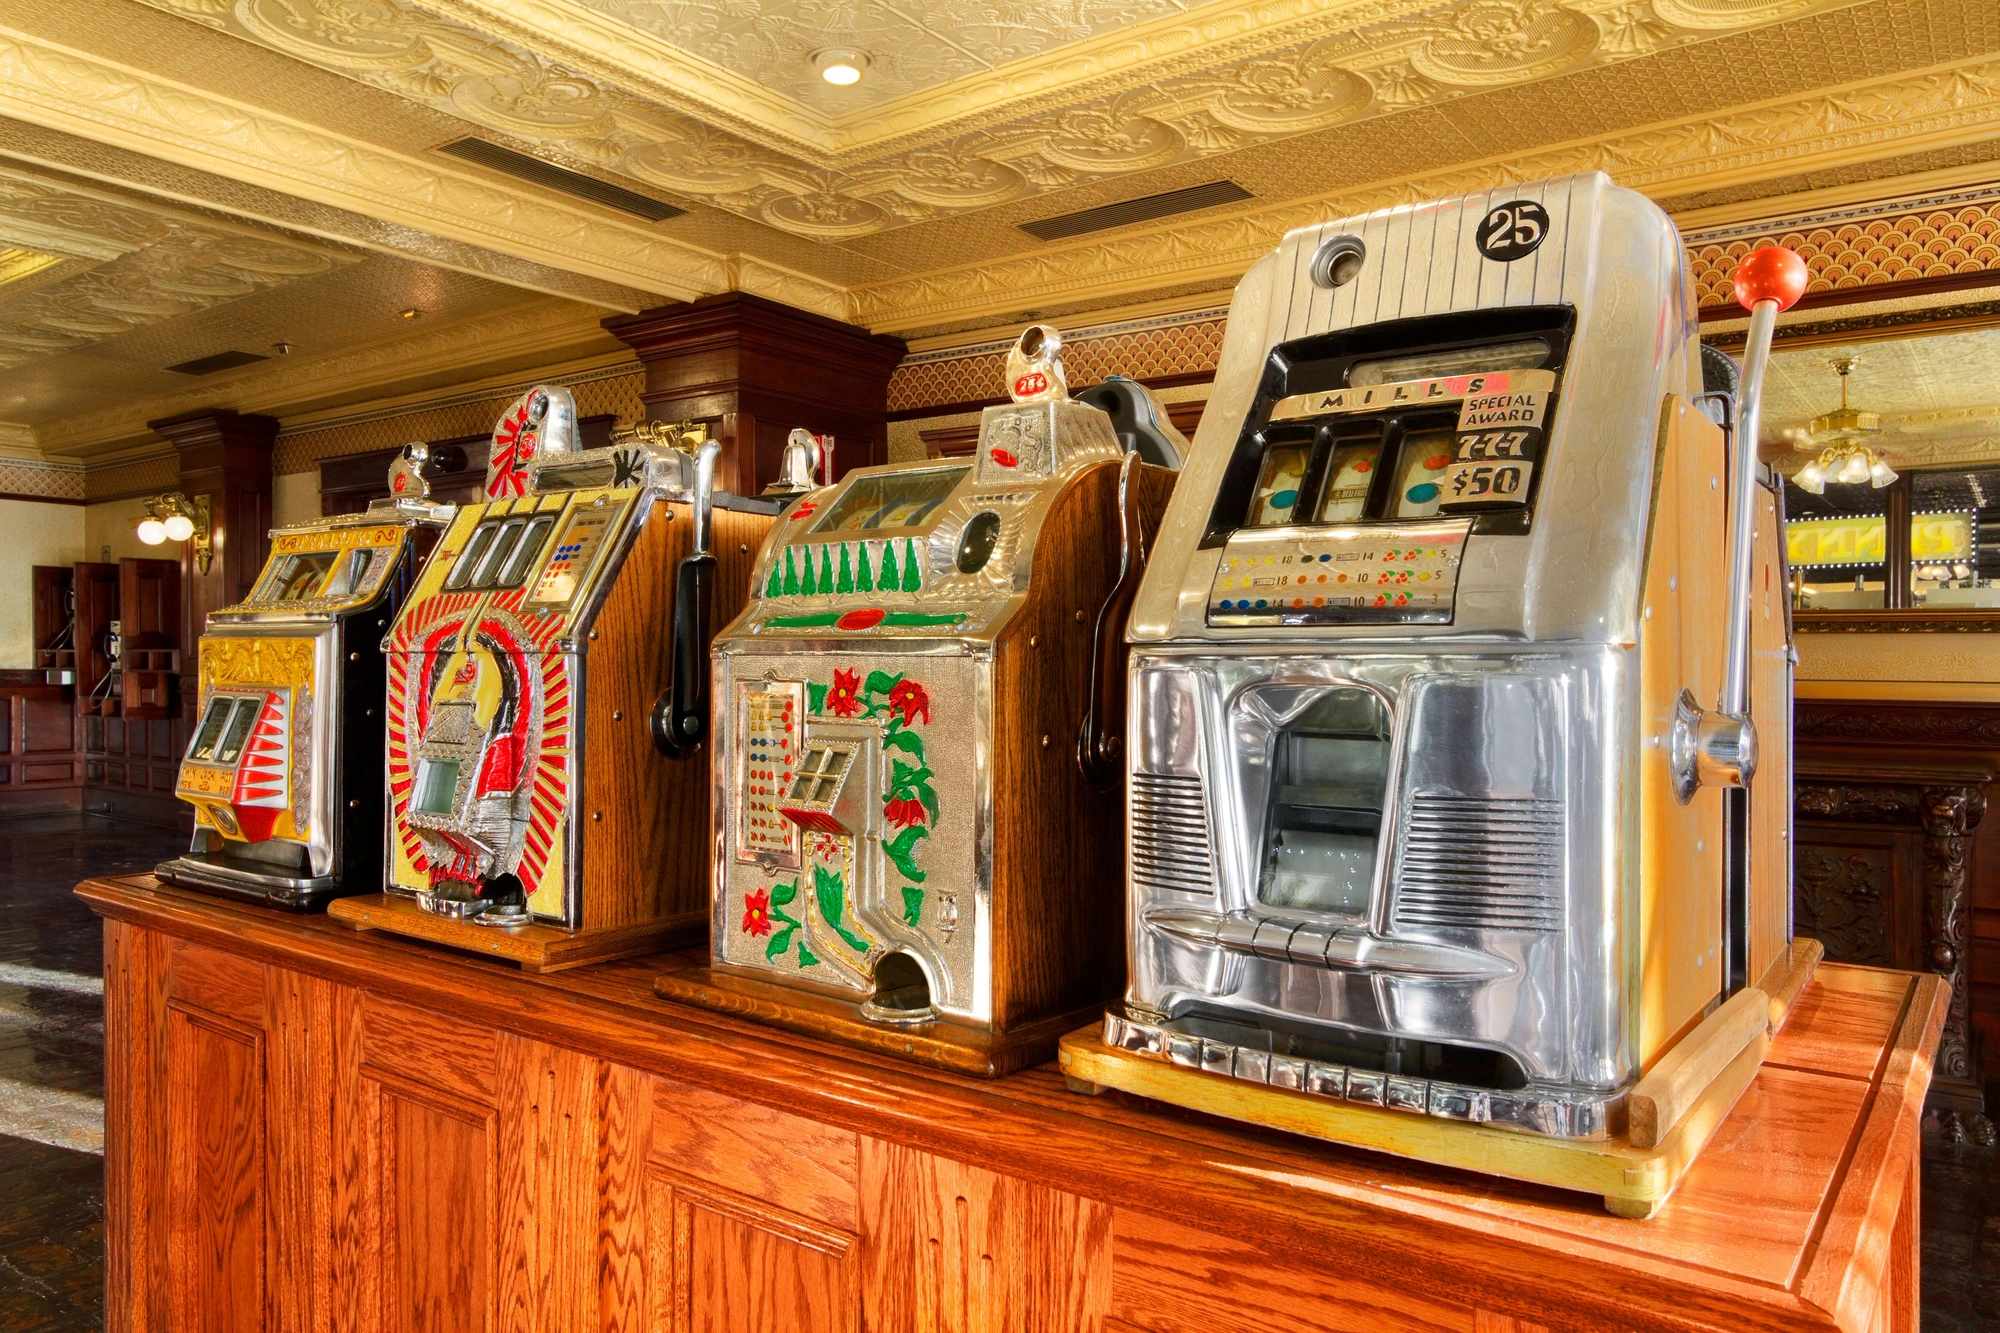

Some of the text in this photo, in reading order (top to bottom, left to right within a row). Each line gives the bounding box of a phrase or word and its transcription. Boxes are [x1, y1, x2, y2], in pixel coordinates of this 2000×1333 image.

[1487, 204, 1541, 251] 25
[1319, 377, 1486, 411] MILLS
[1469, 394, 1536, 411] SPECIAL
[1465, 409, 1534, 426] AWARD
[824, 439, 833, 447] FIRE
[1458, 431, 1529, 460] 7-7-7
[1451, 466, 1521, 496] $50
[1281, 555, 1293, 565] 18
[1362, 552, 1374, 562] 14
[1440, 549, 1448, 558] 5
[1276, 576, 1288, 586] 18
[1357, 573, 1369, 583] 10
[1434, 570, 1442, 580] 5
[1272, 599, 1284, 608] 14
[1354, 596, 1366, 607] 10
[1431, 594, 1438, 604] 3
